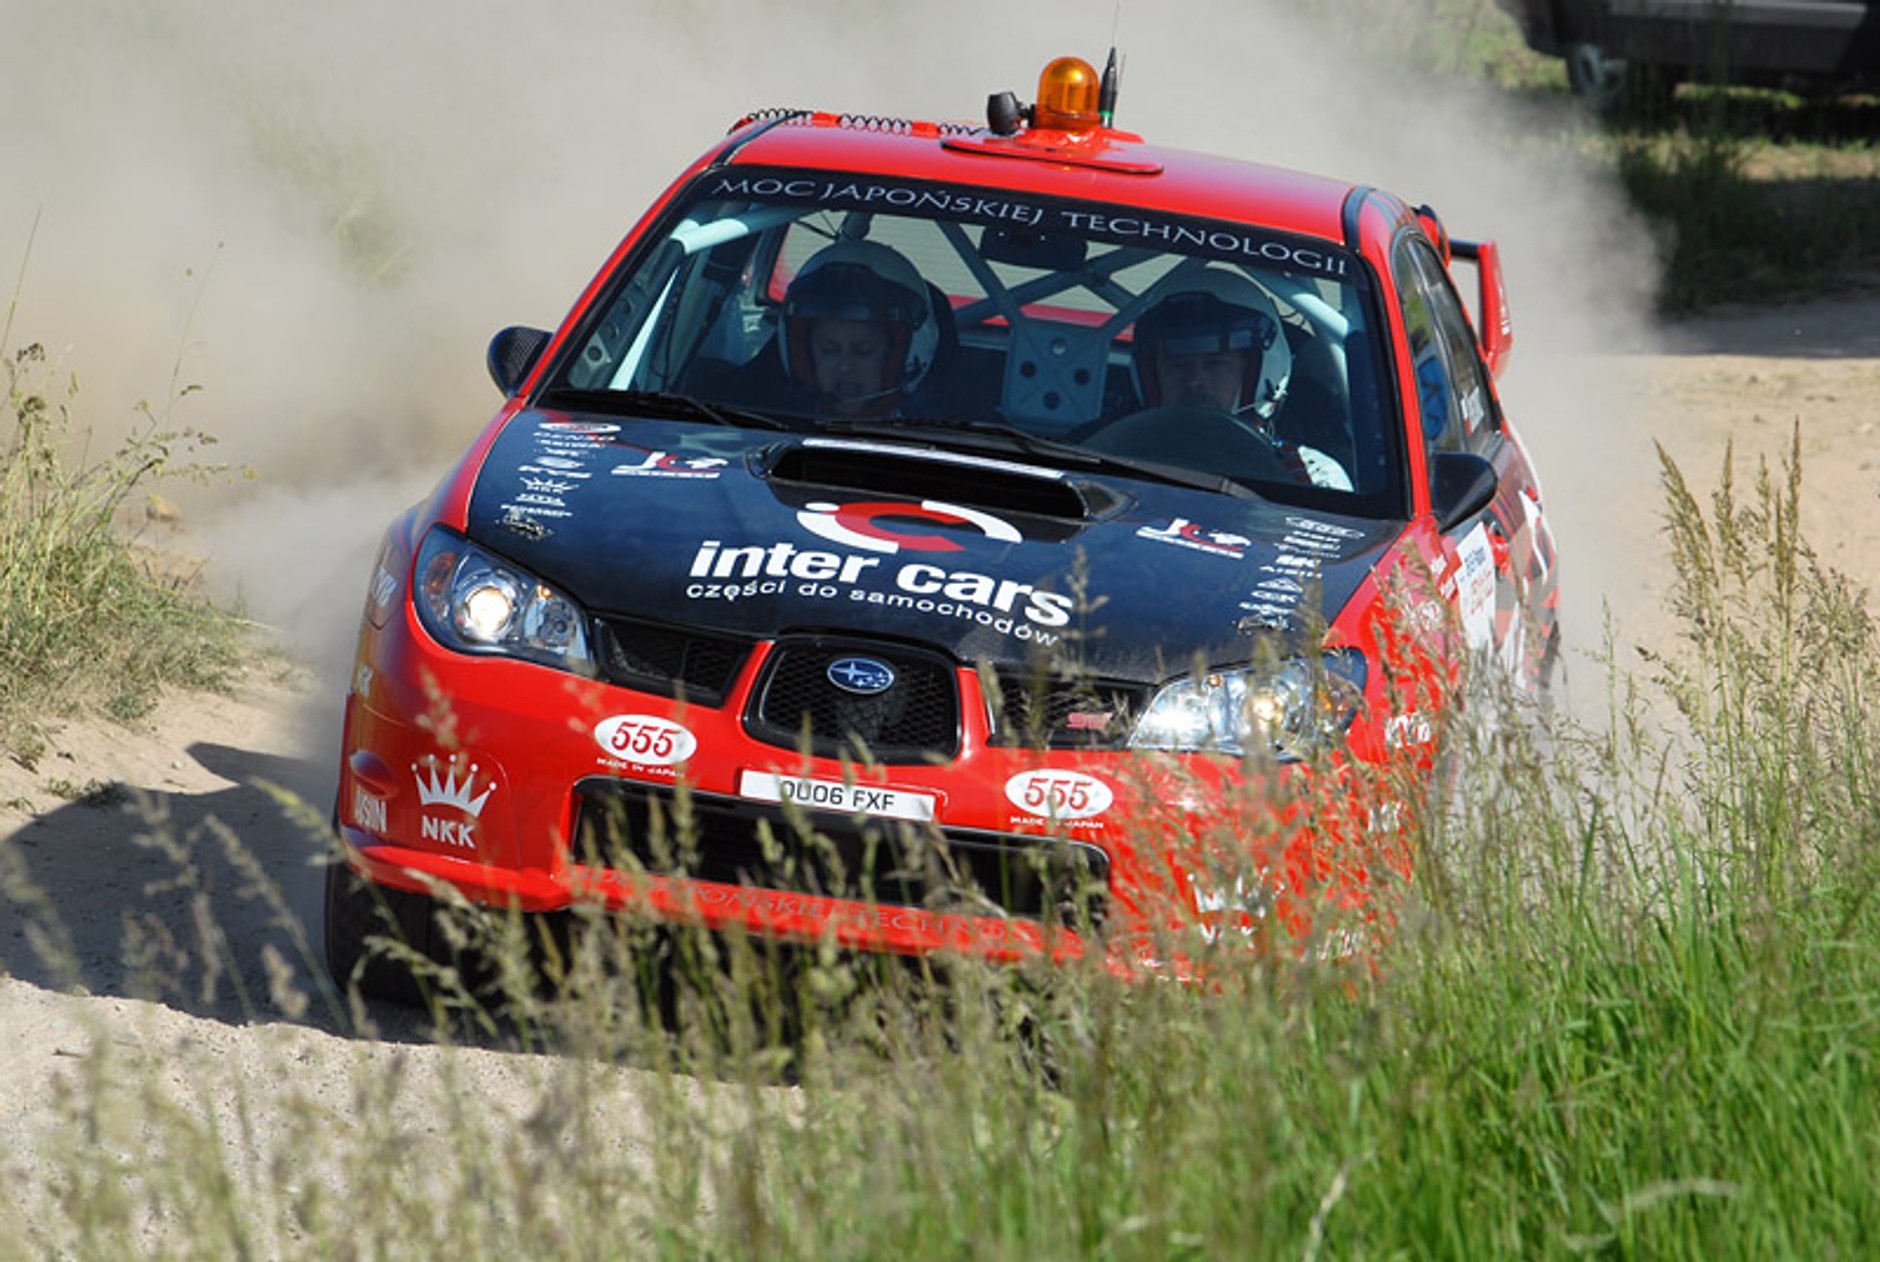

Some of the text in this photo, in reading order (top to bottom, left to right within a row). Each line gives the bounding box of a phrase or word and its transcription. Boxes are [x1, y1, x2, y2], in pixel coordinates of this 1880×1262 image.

[711, 178, 1349, 275] MOC JAPOŃSKIEJ TECHNOLOGII
[689, 539, 1074, 627] inter cars
[686, 580, 1060, 648] części do samochodów
[611, 721, 682, 757] 555
[853, 789, 895, 811] FXF
[1024, 777, 1093, 811] 555
[422, 814, 476, 849] NKK
